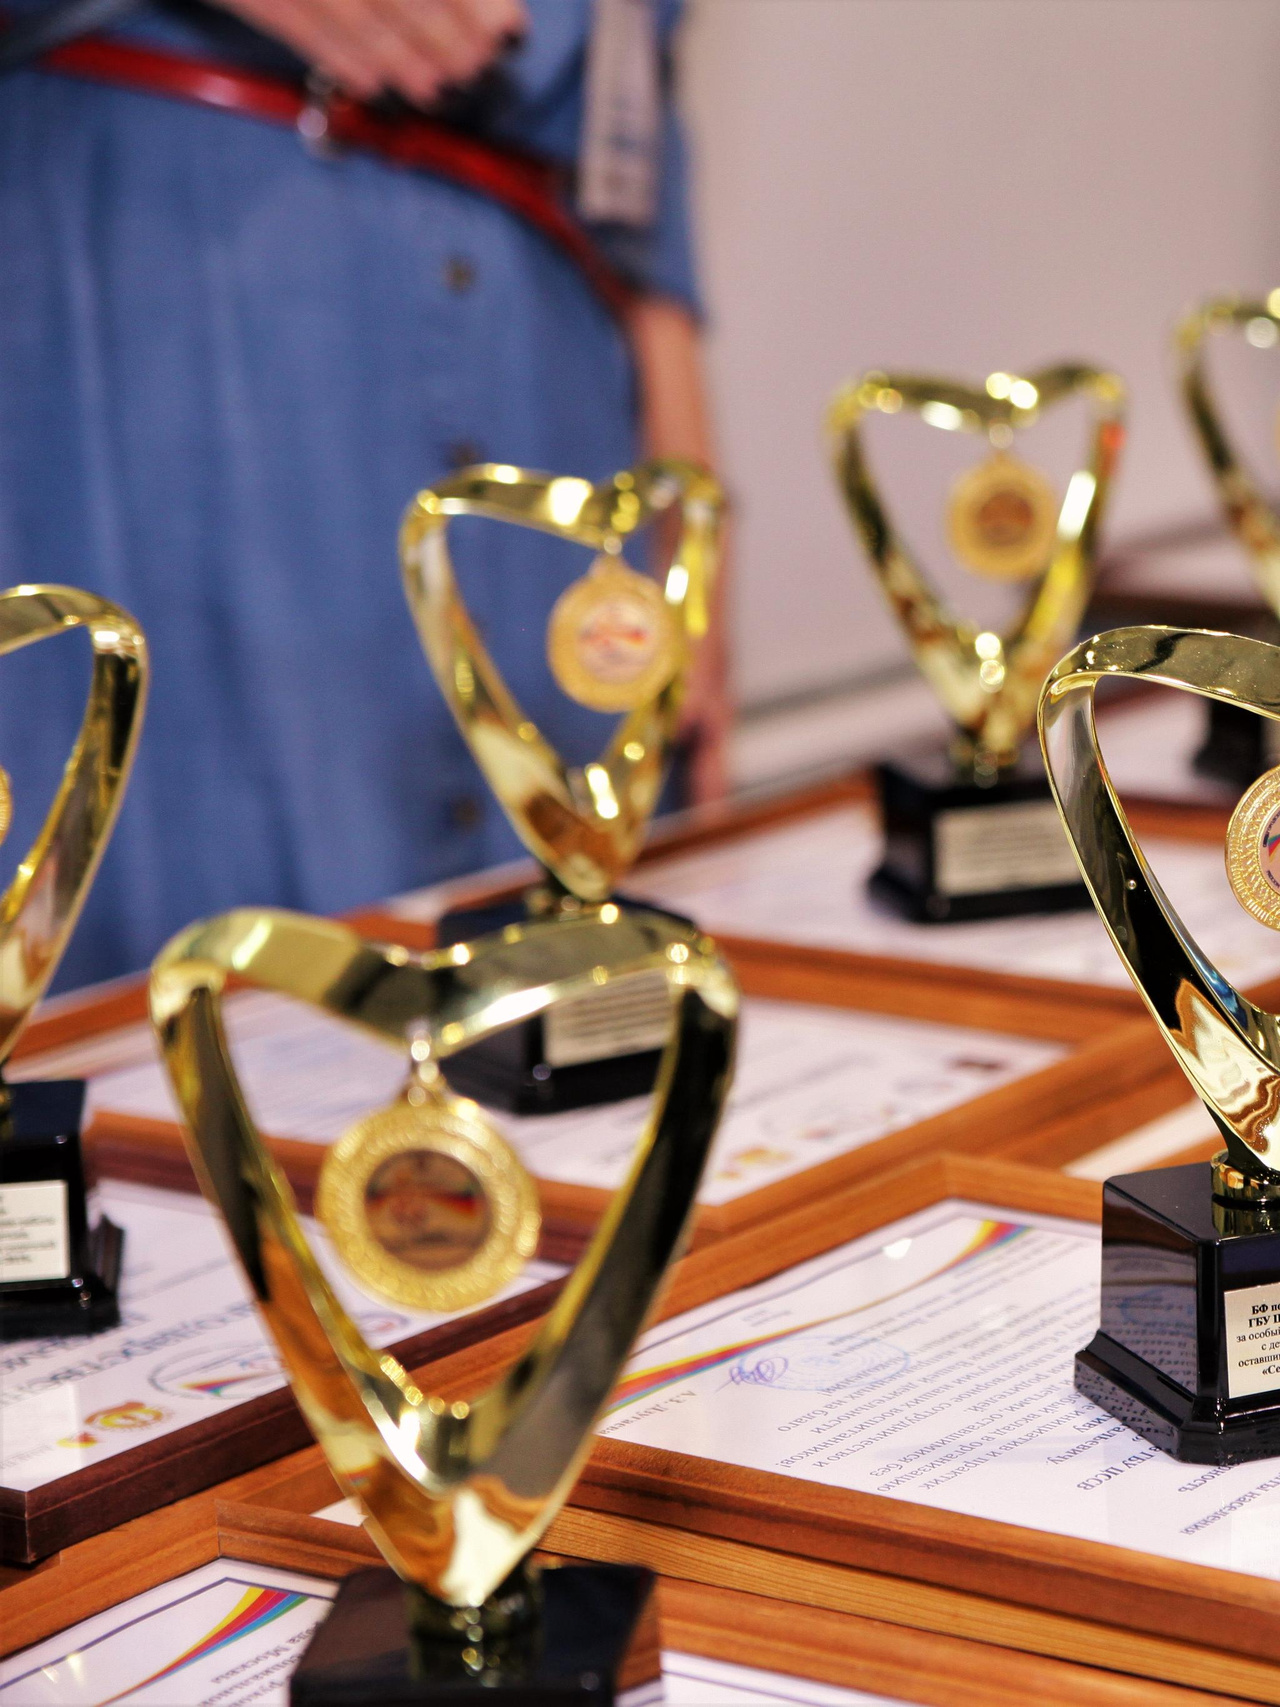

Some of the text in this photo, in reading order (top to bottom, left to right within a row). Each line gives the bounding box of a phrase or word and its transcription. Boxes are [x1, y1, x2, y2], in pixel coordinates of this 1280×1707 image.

[1248, 1316, 1270, 1328] ГБУ
[1252, 1304, 1268, 1315] БФ
[1237, 1334, 1246, 1343] за
[776, 1408, 904, 1468] воспитанников!
[827, 1403, 951, 1461] сотрудничество
[897, 1414, 1003, 1463] оставшимися
[988, 1413, 1041, 1435] вклад
[999, 1410, 1085, 1451] инициатив
[870, 1464, 903, 1476] без
[877, 1442, 983, 1491] организацию
[919, 1457, 990, 1489] практик
[1077, 1452, 1154, 1490] ГБУ ЦССВ
[1180, 1491, 1261, 1535] населения
[211, 1646, 290, 1684] Москвы
